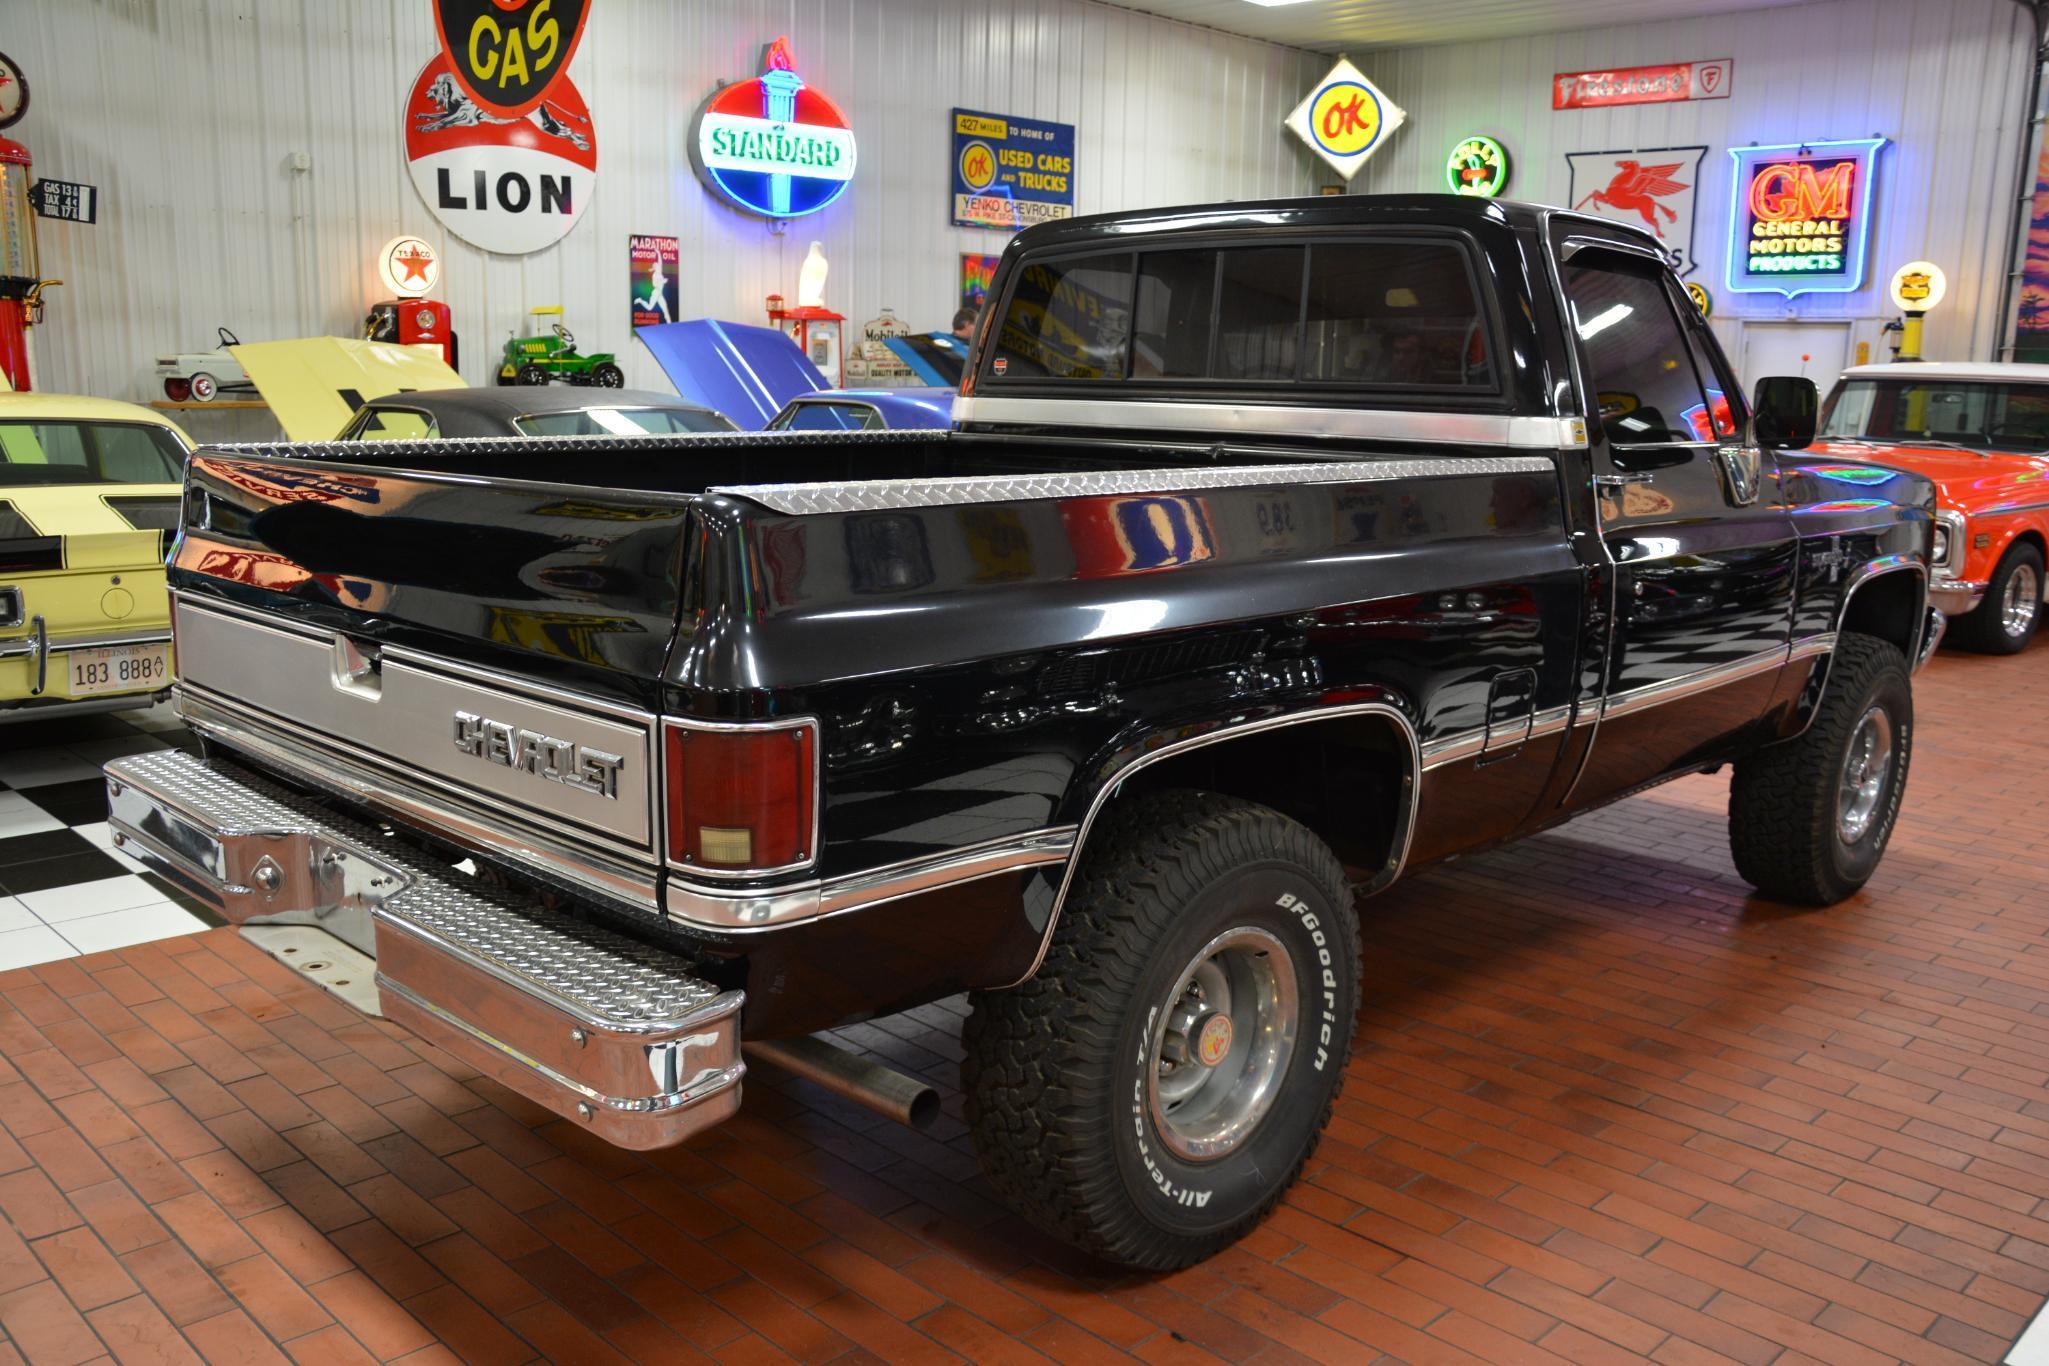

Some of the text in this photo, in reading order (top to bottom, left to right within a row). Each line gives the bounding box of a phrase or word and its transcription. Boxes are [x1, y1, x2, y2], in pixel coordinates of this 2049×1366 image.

[468, 0, 559, 88] GAS
[1559, 74, 1683, 106] Firestone
[960, 119, 978, 130] 427
[1323, 93, 1369, 138] OK
[1009, 127, 1054, 141] TO HOME OF
[712, 127, 840, 167] STANDARD
[968, 153, 989, 178] OK
[999, 149, 1071, 174] USED CARS
[44, 182, 60, 194] GAS
[437, 167, 573, 215] LION
[1018, 172, 1067, 192] TRUCKS
[1750, 162, 1854, 221] GM
[44, 193, 60, 206] TAX
[963, 196, 1066, 218] YENKO CHEVROLET
[1752, 219, 1842, 237] GENERAL
[398, 250, 430, 258] TEXACO
[631, 237, 678, 250] MARATHON
[662, 252, 675, 260] OIL
[1749, 237, 1842, 254] MOTORS
[75, 662, 109, 686] 183
[120, 658, 152, 680] 888
[454, 710, 625, 800] CHEVROLET
[1275, 892, 1337, 1072] BFGoodrich
[1132, 1079, 1214, 1208] All-Terrain
